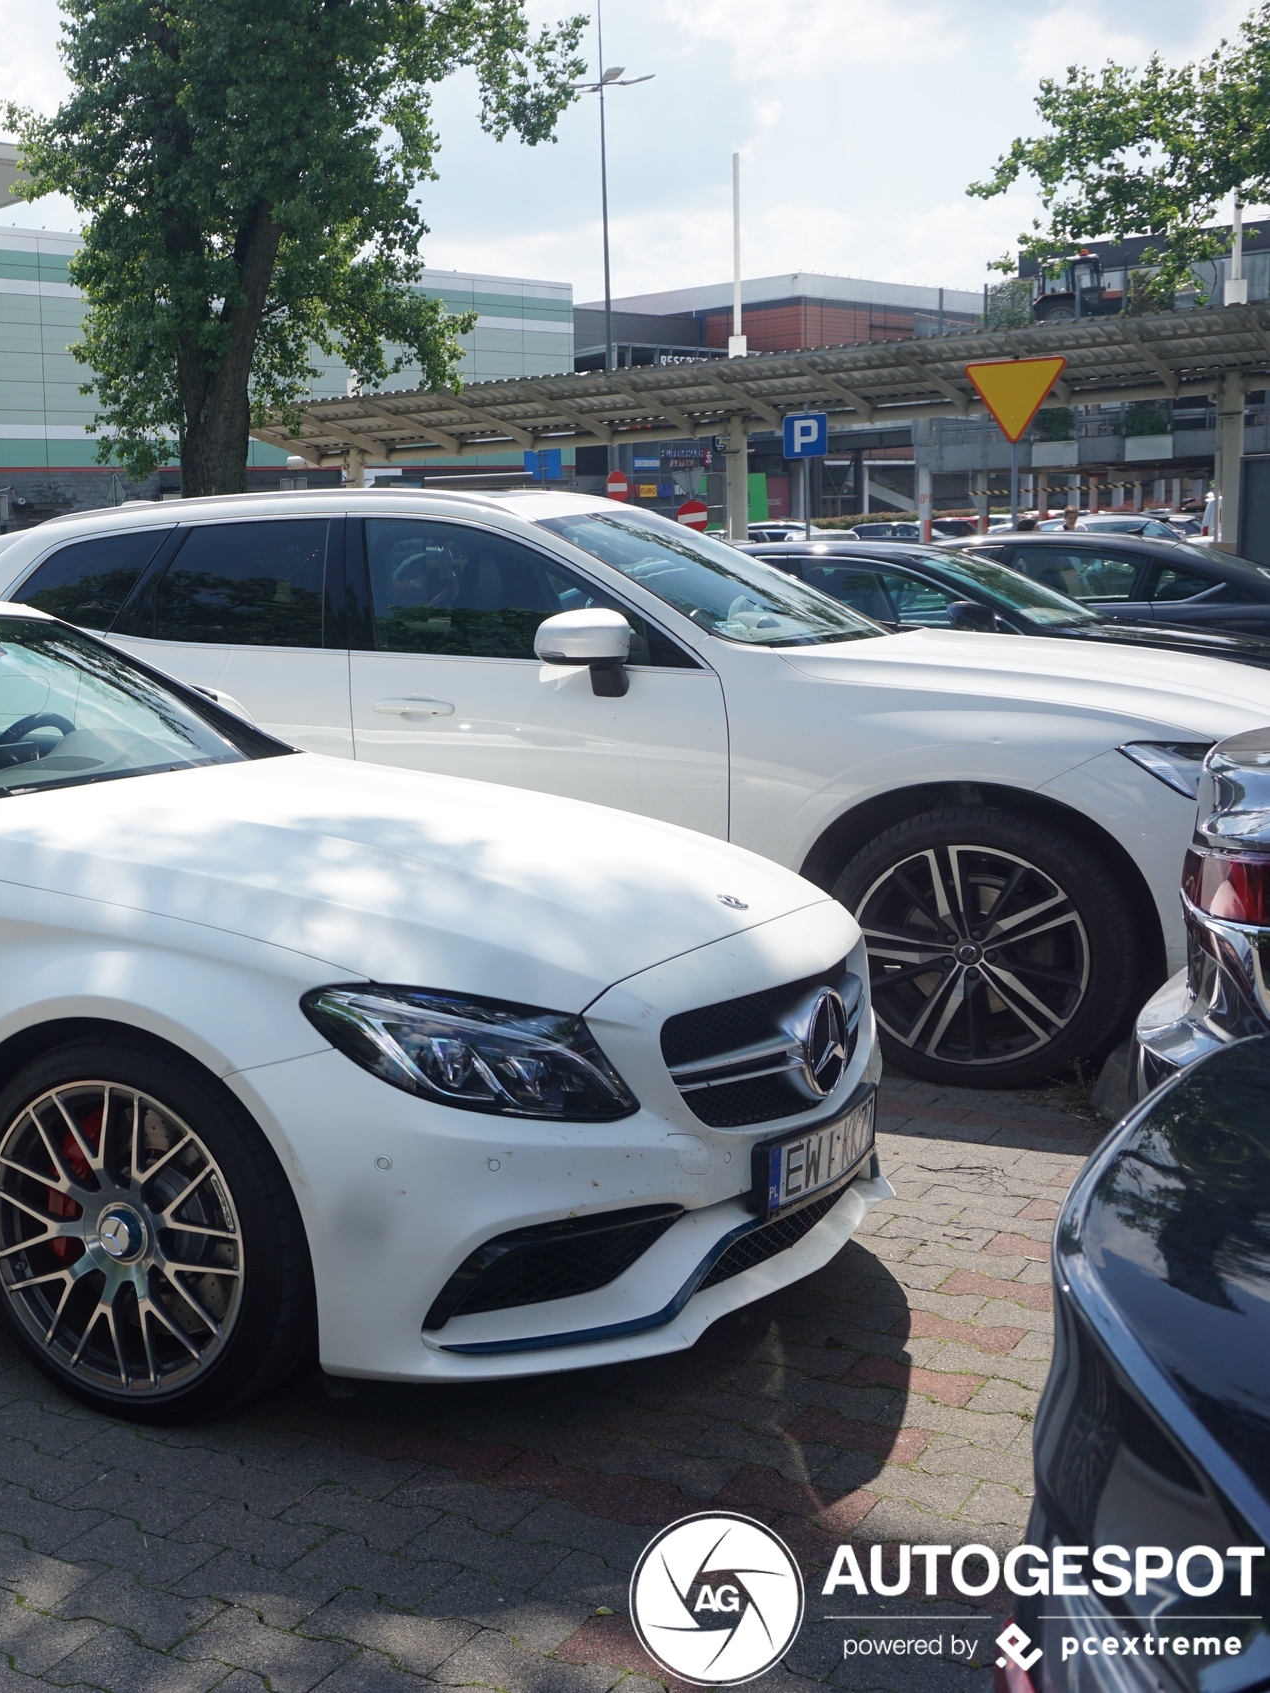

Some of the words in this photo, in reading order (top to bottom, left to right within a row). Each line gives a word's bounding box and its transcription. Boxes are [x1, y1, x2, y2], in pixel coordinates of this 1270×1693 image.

[794, 419, 818, 453] P
[786, 1136, 822, 1197] EW
[769, 1184, 779, 1200] PL
